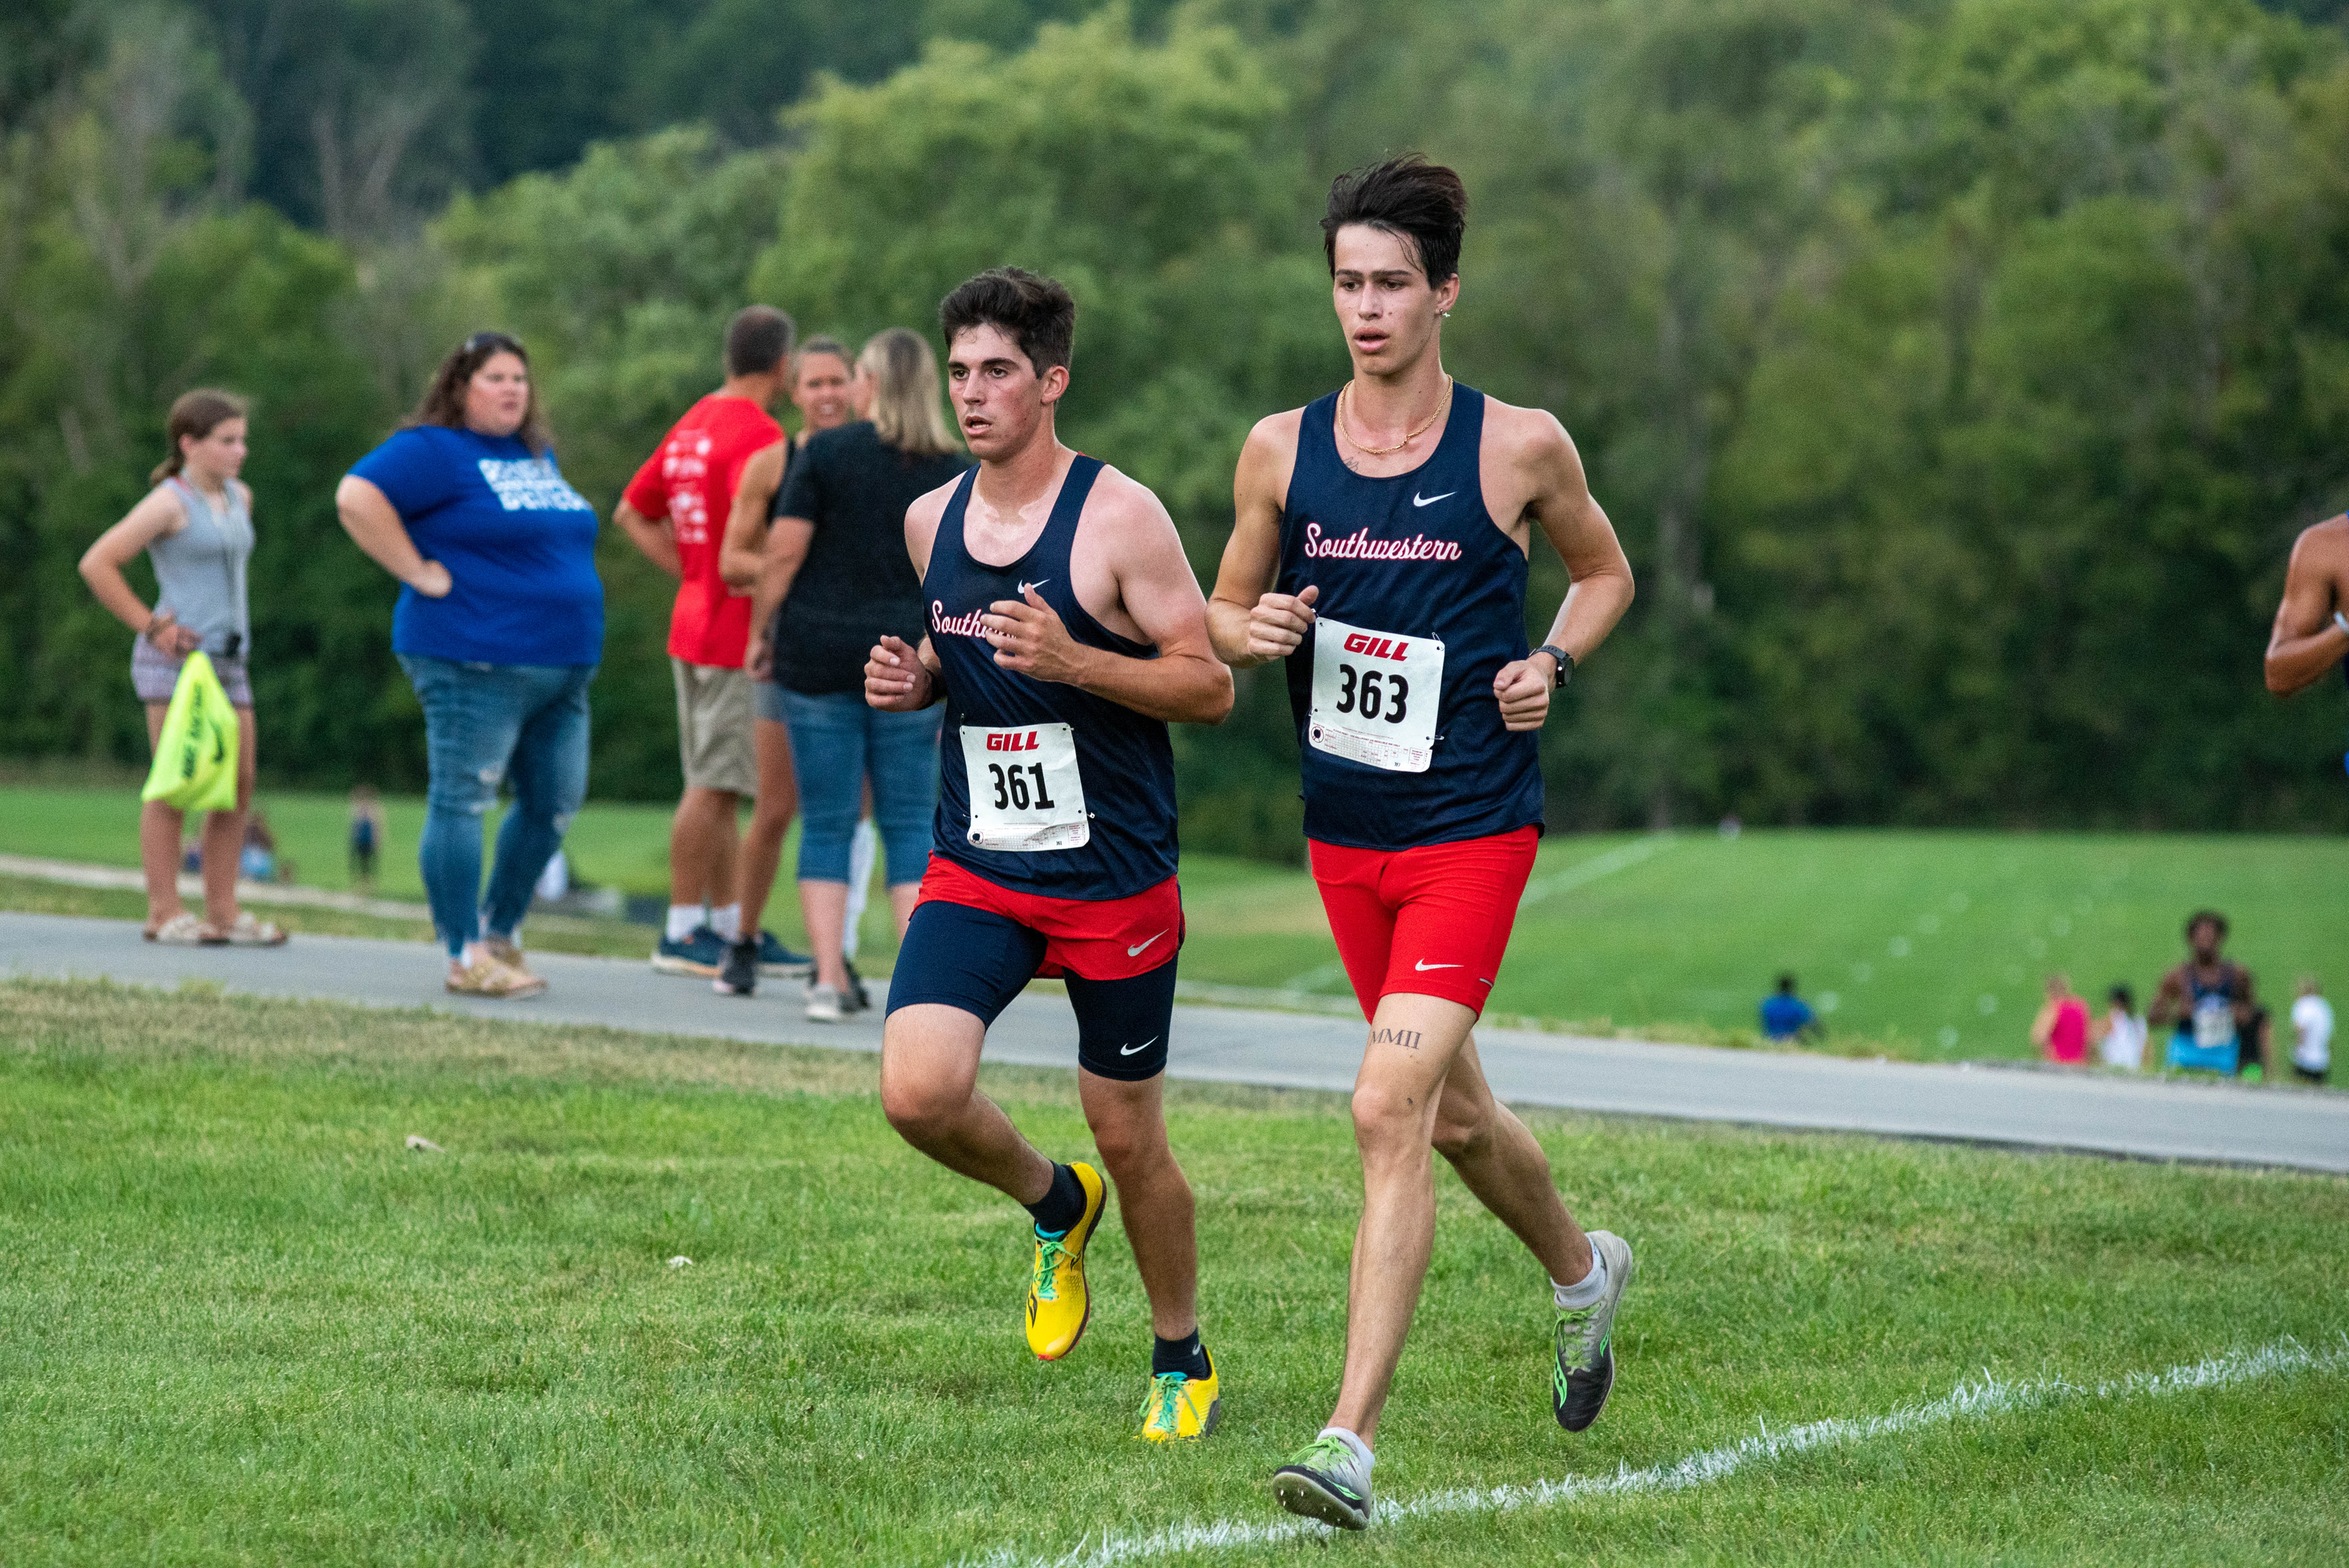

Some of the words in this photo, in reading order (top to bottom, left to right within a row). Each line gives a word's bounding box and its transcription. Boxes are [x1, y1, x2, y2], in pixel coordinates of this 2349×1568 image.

[1305, 522, 1462, 560] Southwestern
[1344, 633, 1409, 662] GILL
[1336, 664, 1409, 724] 363
[986, 731, 1040, 752] GILL
[988, 762, 1055, 810] 361
